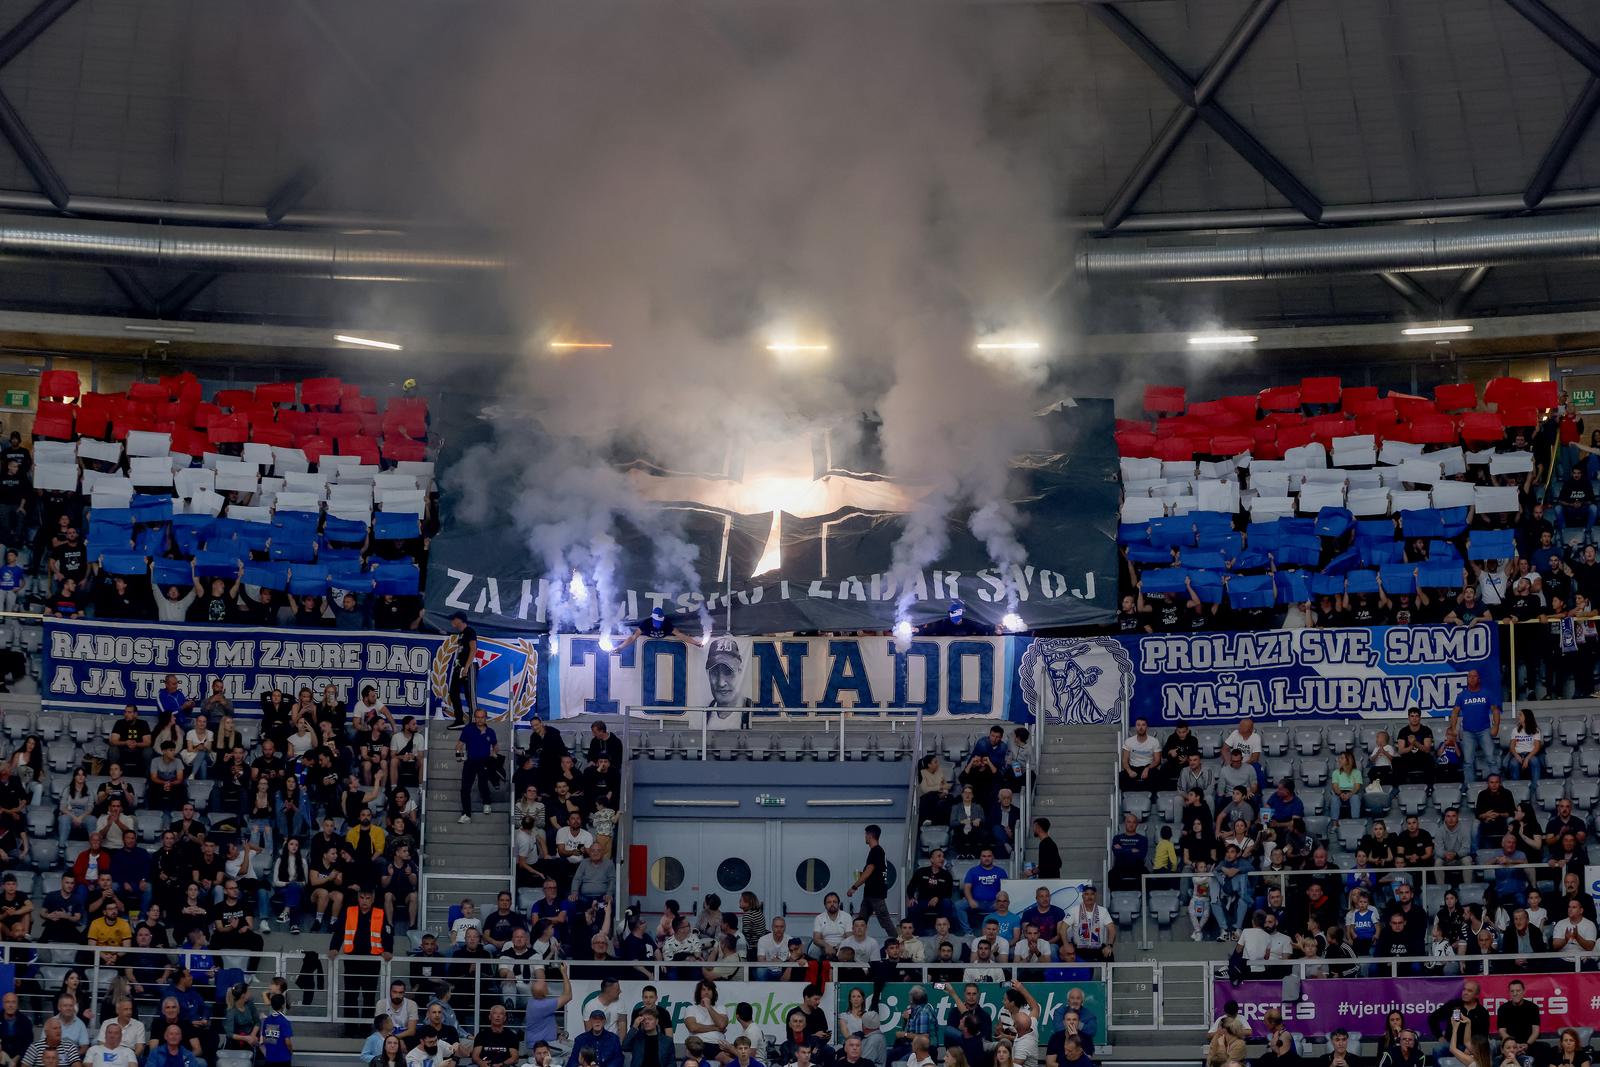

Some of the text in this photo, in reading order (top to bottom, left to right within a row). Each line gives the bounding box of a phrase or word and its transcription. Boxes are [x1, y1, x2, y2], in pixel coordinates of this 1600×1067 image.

[1573, 391, 1594, 400] IZLAZ
[446, 568, 503, 616] ZA
[975, 564, 1096, 602] SVOJ
[51, 631, 431, 675] RADOST SI MI ZADRE DAO
[1140, 624, 1491, 674] PROLAZI SVE, SAMO
[51, 665, 78, 695] A
[81, 668, 128, 698] JA
[1162, 673, 1266, 721] NAŠA
[1269, 676, 1413, 718] LJUBAV
[1464, 697, 1487, 705] ZADAR
